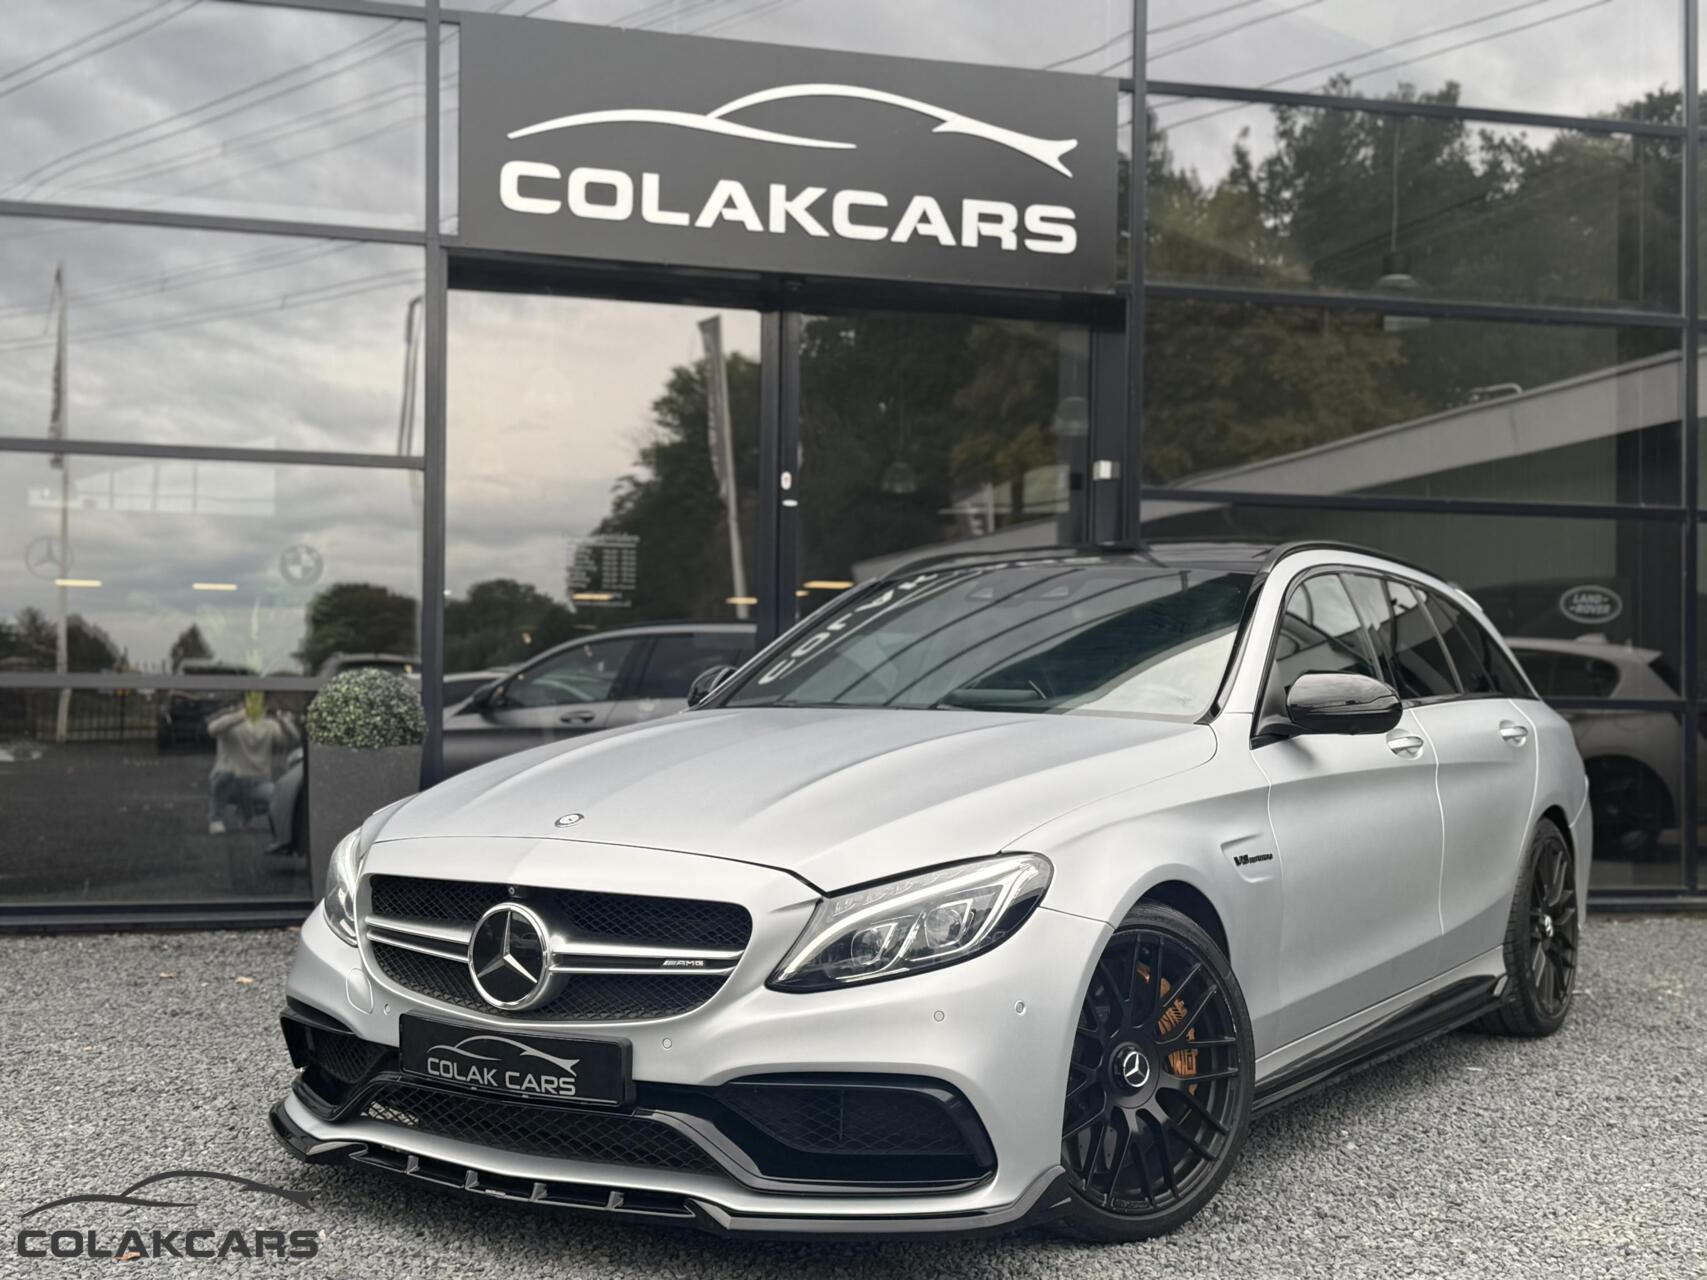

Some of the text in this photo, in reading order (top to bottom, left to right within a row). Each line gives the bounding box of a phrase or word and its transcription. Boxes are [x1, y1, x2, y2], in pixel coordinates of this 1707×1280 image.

[499, 161, 1078, 255] COLAKCARS
[427, 1057, 576, 1096] COLAK CARS
